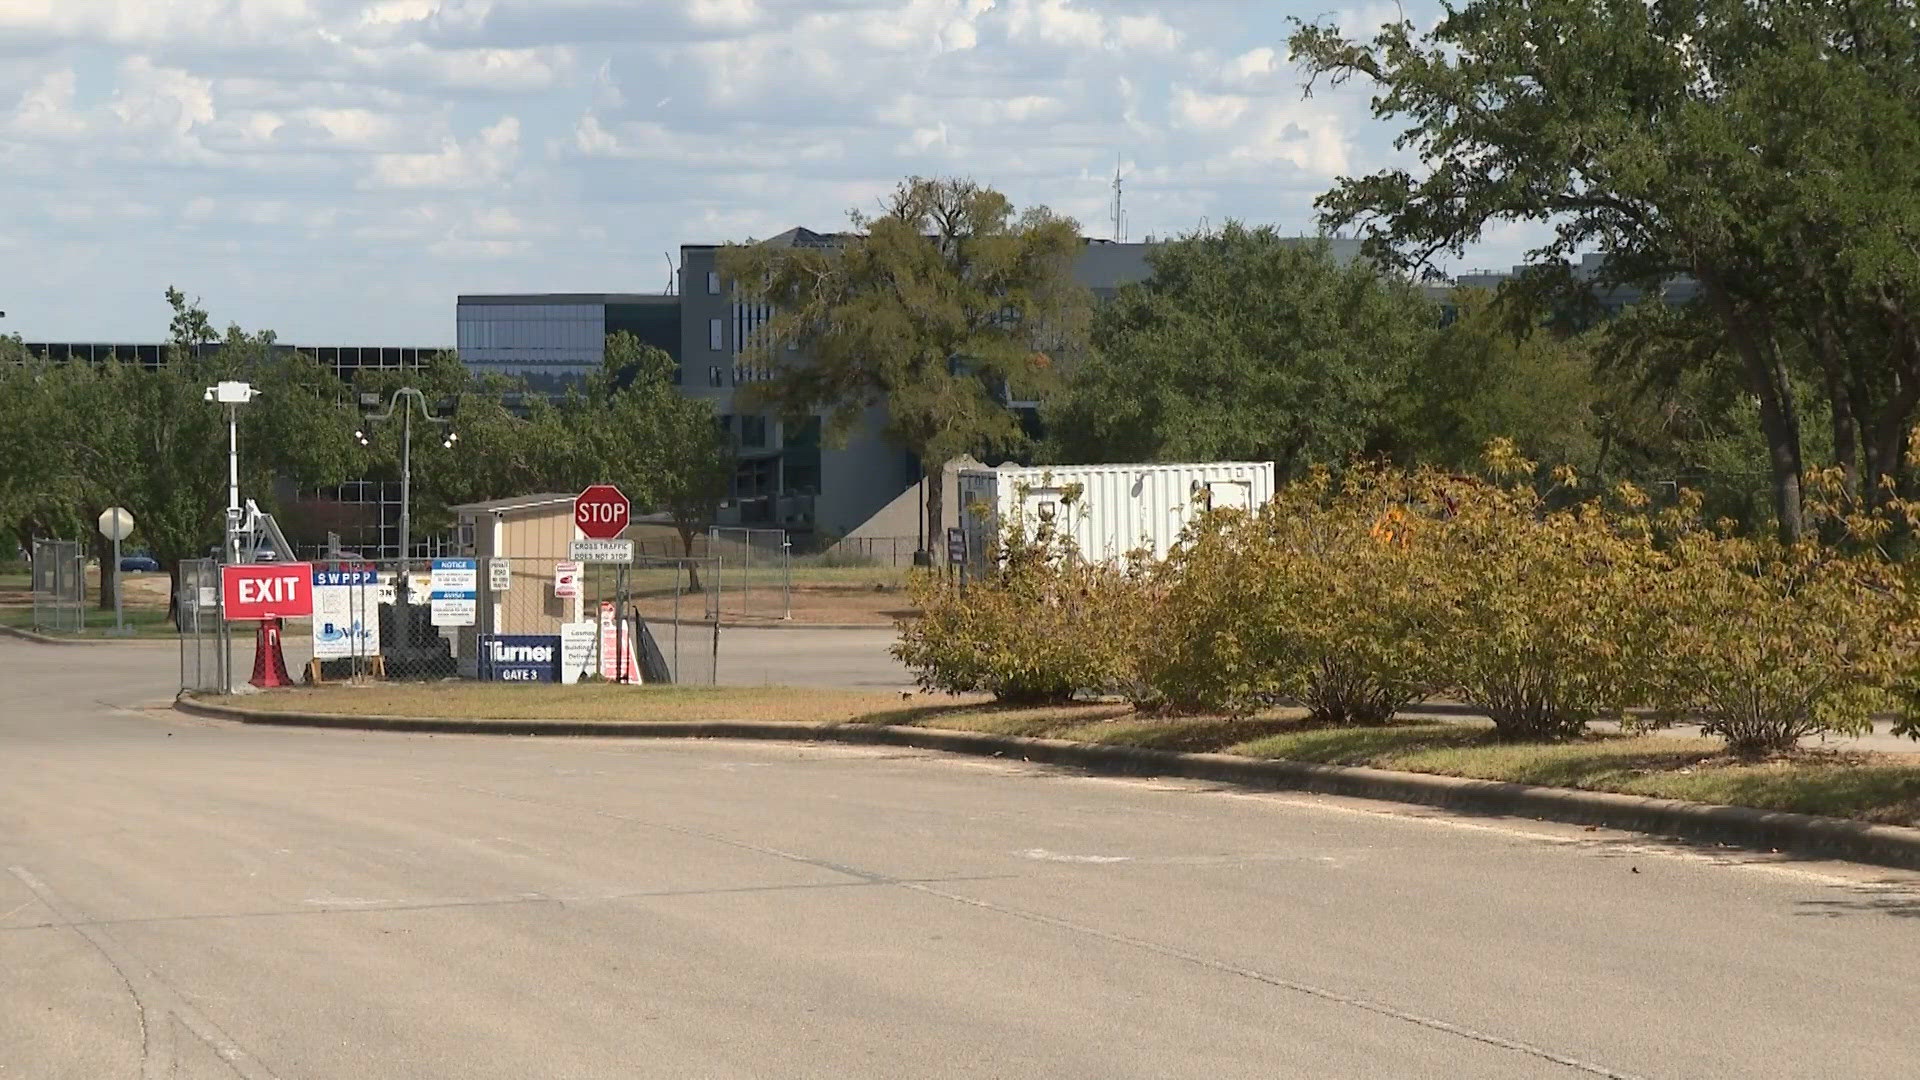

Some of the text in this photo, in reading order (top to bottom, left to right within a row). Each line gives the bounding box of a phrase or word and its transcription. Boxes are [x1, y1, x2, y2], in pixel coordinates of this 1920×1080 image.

[578, 503, 625, 522] STOP
[441, 561, 467, 569] NOTICE
[239, 577, 299, 604] EXIT
[484, 641, 555, 662] Turner
[503, 669, 537, 680] GATE 3
